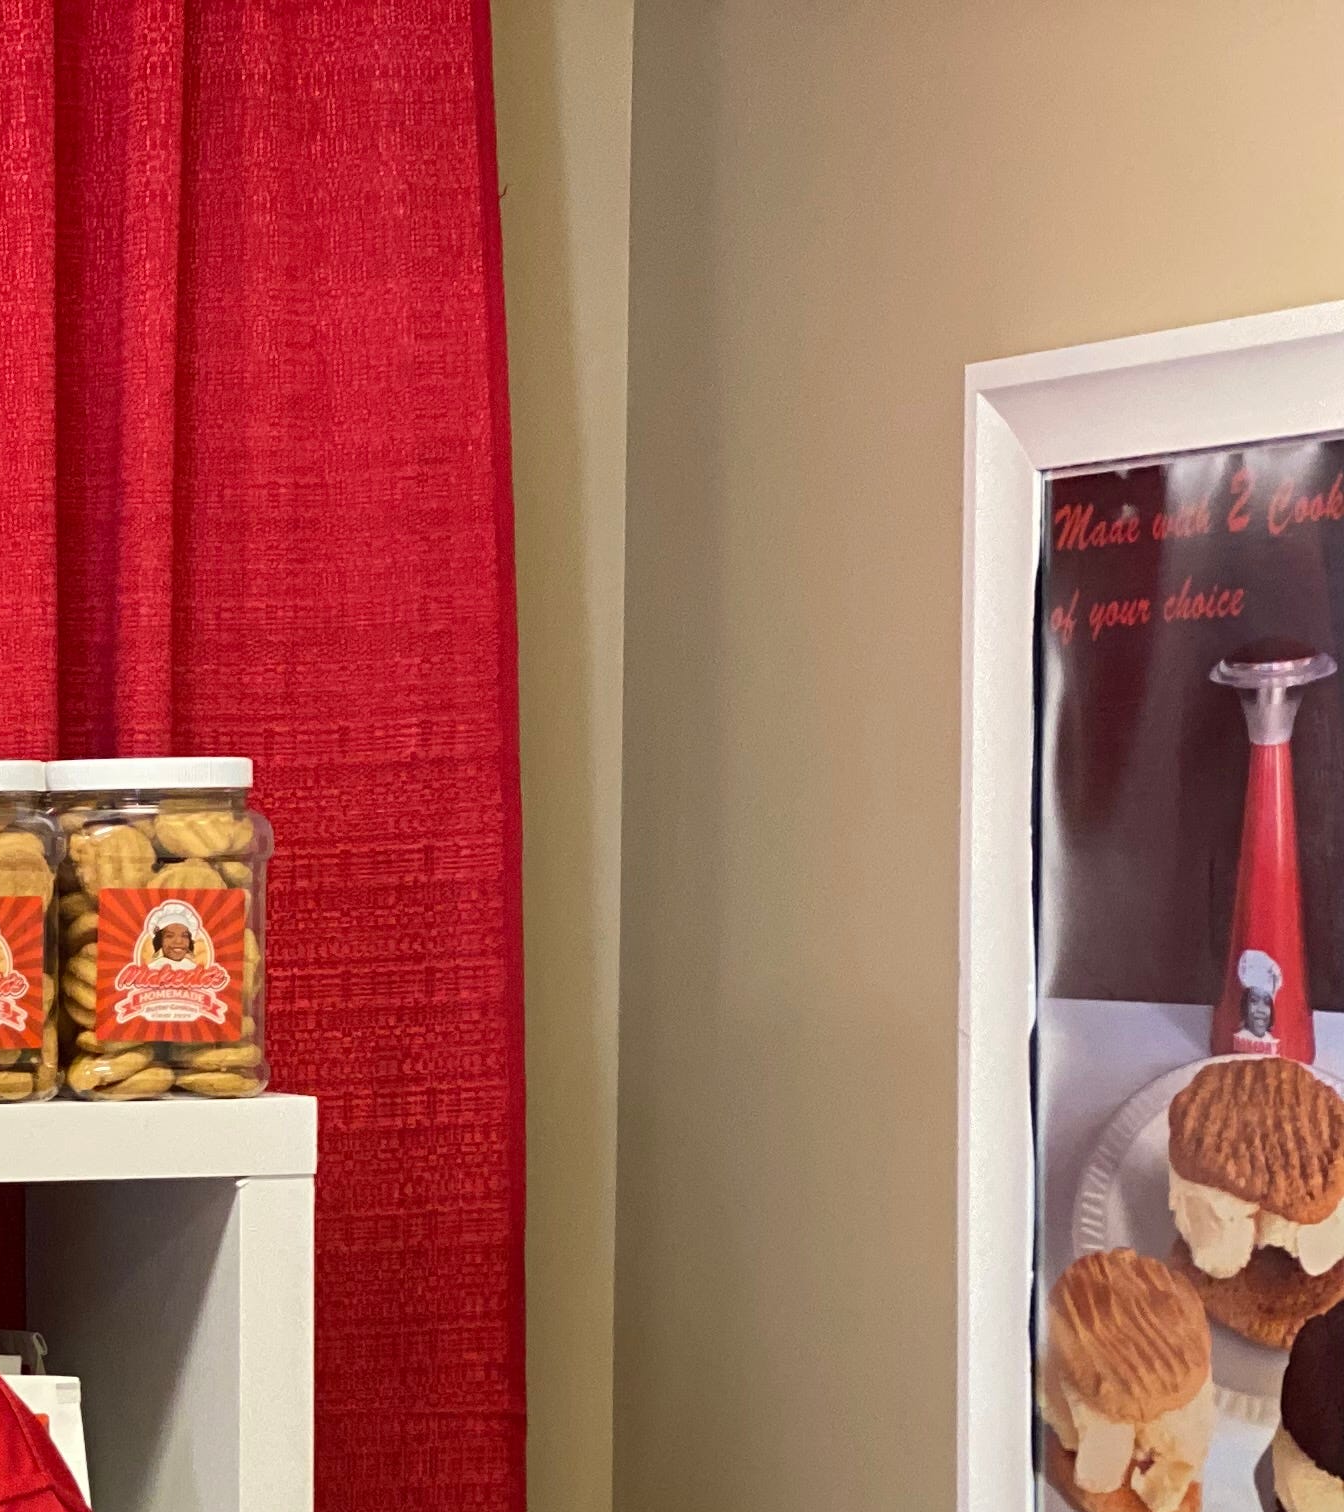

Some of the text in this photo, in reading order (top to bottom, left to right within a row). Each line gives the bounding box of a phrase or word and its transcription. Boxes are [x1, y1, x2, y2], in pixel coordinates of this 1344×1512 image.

[1055, 502, 1141, 551] Made
[1227, 467, 1257, 533] 2
[1050, 574, 1248, 646] of your choice
[118, 963, 228, 989] Makeda's
[139, 989, 205, 1003] HOMEMADE
